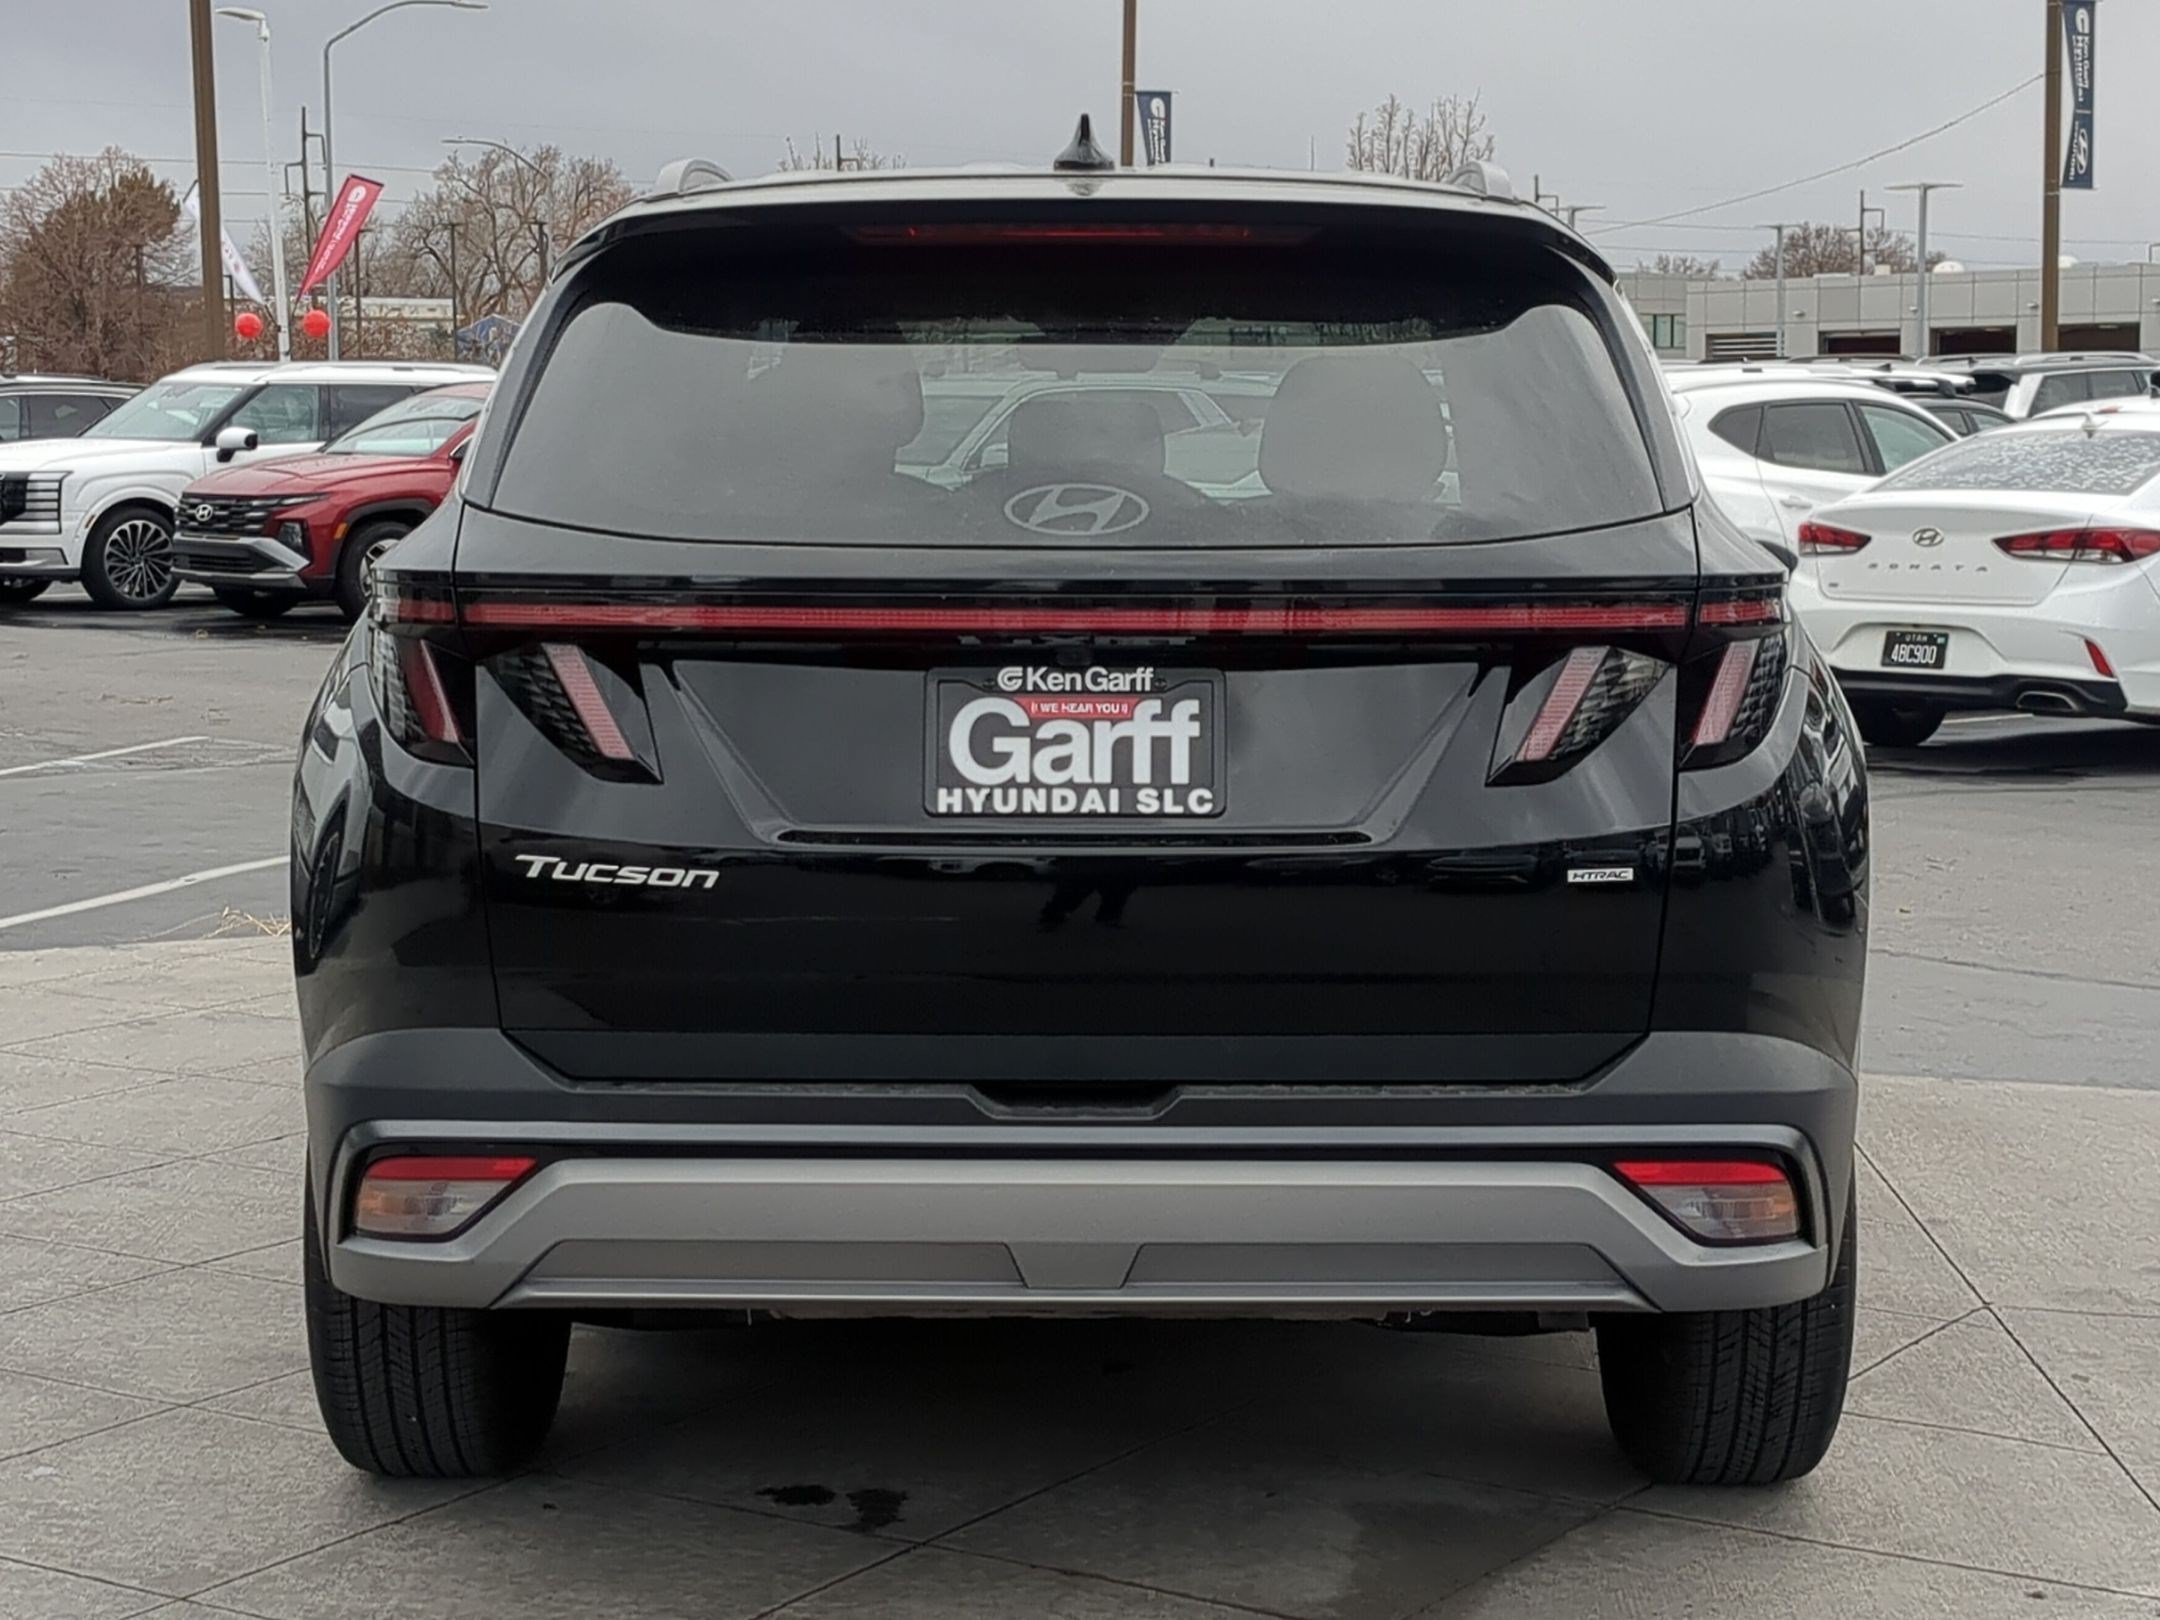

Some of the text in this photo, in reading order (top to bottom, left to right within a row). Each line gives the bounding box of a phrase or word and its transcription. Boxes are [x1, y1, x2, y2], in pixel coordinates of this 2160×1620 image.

[1868, 562, 1988, 572] SONATA
[1026, 666, 1154, 692] Ken Garff
[1040, 702, 1120, 714] WE HEAR YOU
[949, 696, 1200, 786] Garff
[937, 788, 1214, 814] HYUNDAI SLC
[1571, 870, 1630, 881] HTRAC
